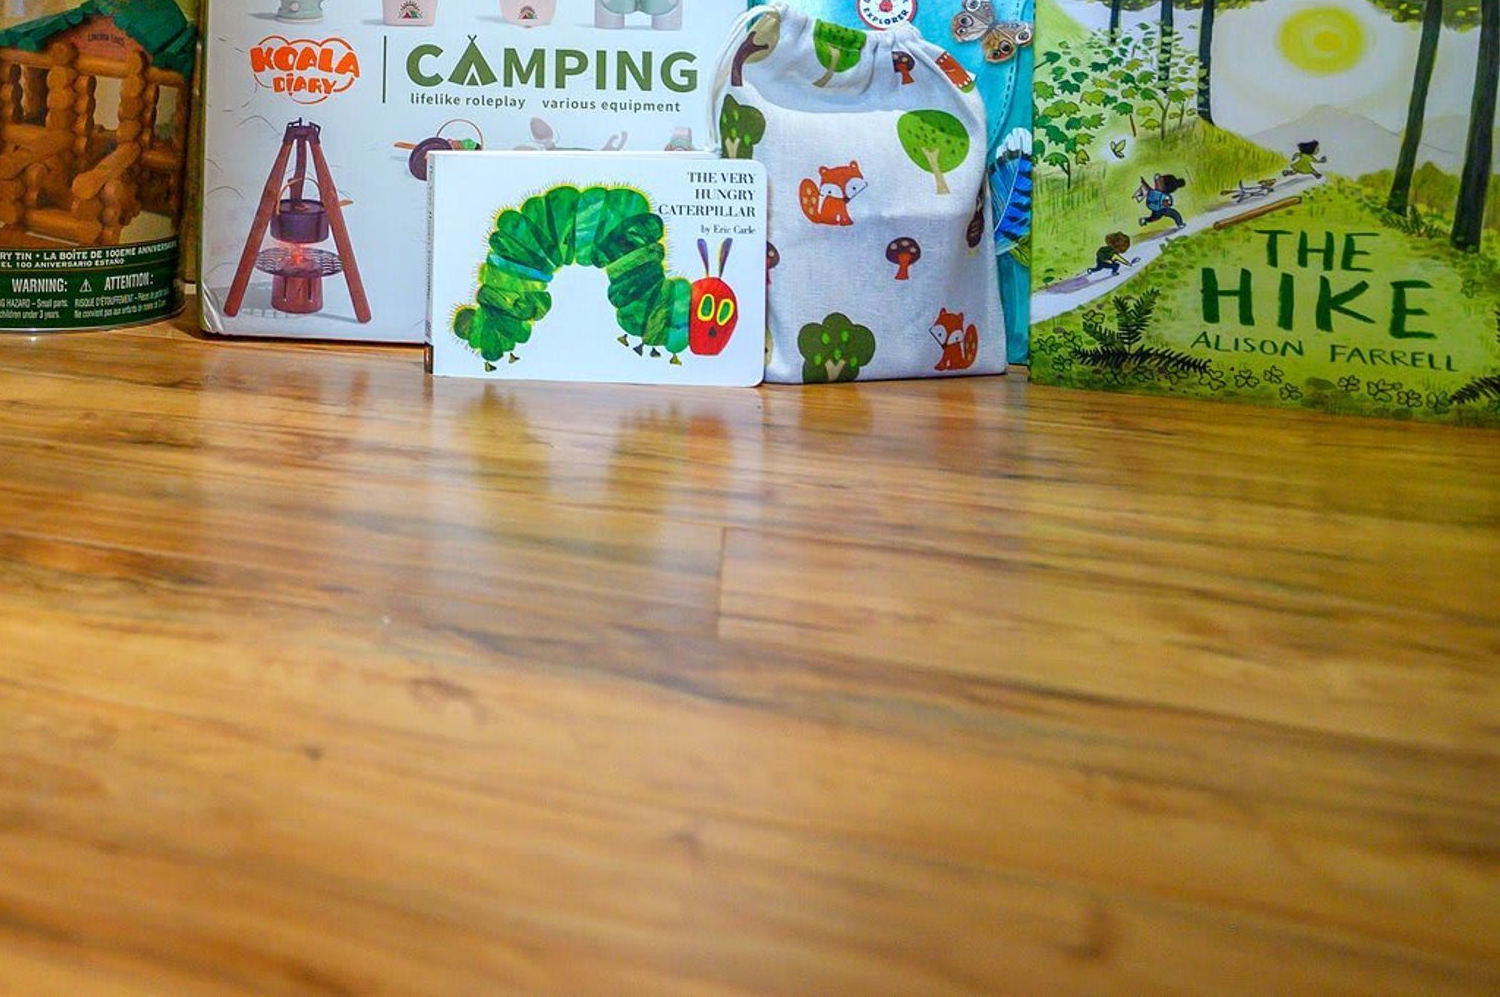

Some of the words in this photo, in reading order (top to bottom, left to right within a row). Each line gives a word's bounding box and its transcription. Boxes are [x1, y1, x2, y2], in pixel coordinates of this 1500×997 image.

[249, 46, 360, 78] KOALA
[405, 36, 699, 93] CAMPING
[410, 93, 461, 105] lifelike
[465, 95, 526, 110] roleplay
[542, 98, 596, 110] various
[601, 98, 681, 113] equipment
[687, 172, 718, 183] THE
[720, 172, 756, 184] VERY
[695, 188, 756, 201] HUNGRY
[658, 203, 756, 217] CATERPILLAR
[701, 224, 710, 235] by
[713, 224, 731, 233] Eric
[733, 224, 756, 234] Carle
[15, 251, 32, 260] TIN
[43, 252, 57, 260] LA
[90, 250, 102, 259] DE
[1252, 229, 1381, 273] THE
[34, 260, 92, 268] ANIVERSARIO
[11, 278, 68, 293] WARNING:
[1200, 267, 1438, 339] HIKE
[1190, 330, 1304, 356] ALISON
[1330, 343, 1460, 372] FARRELL
